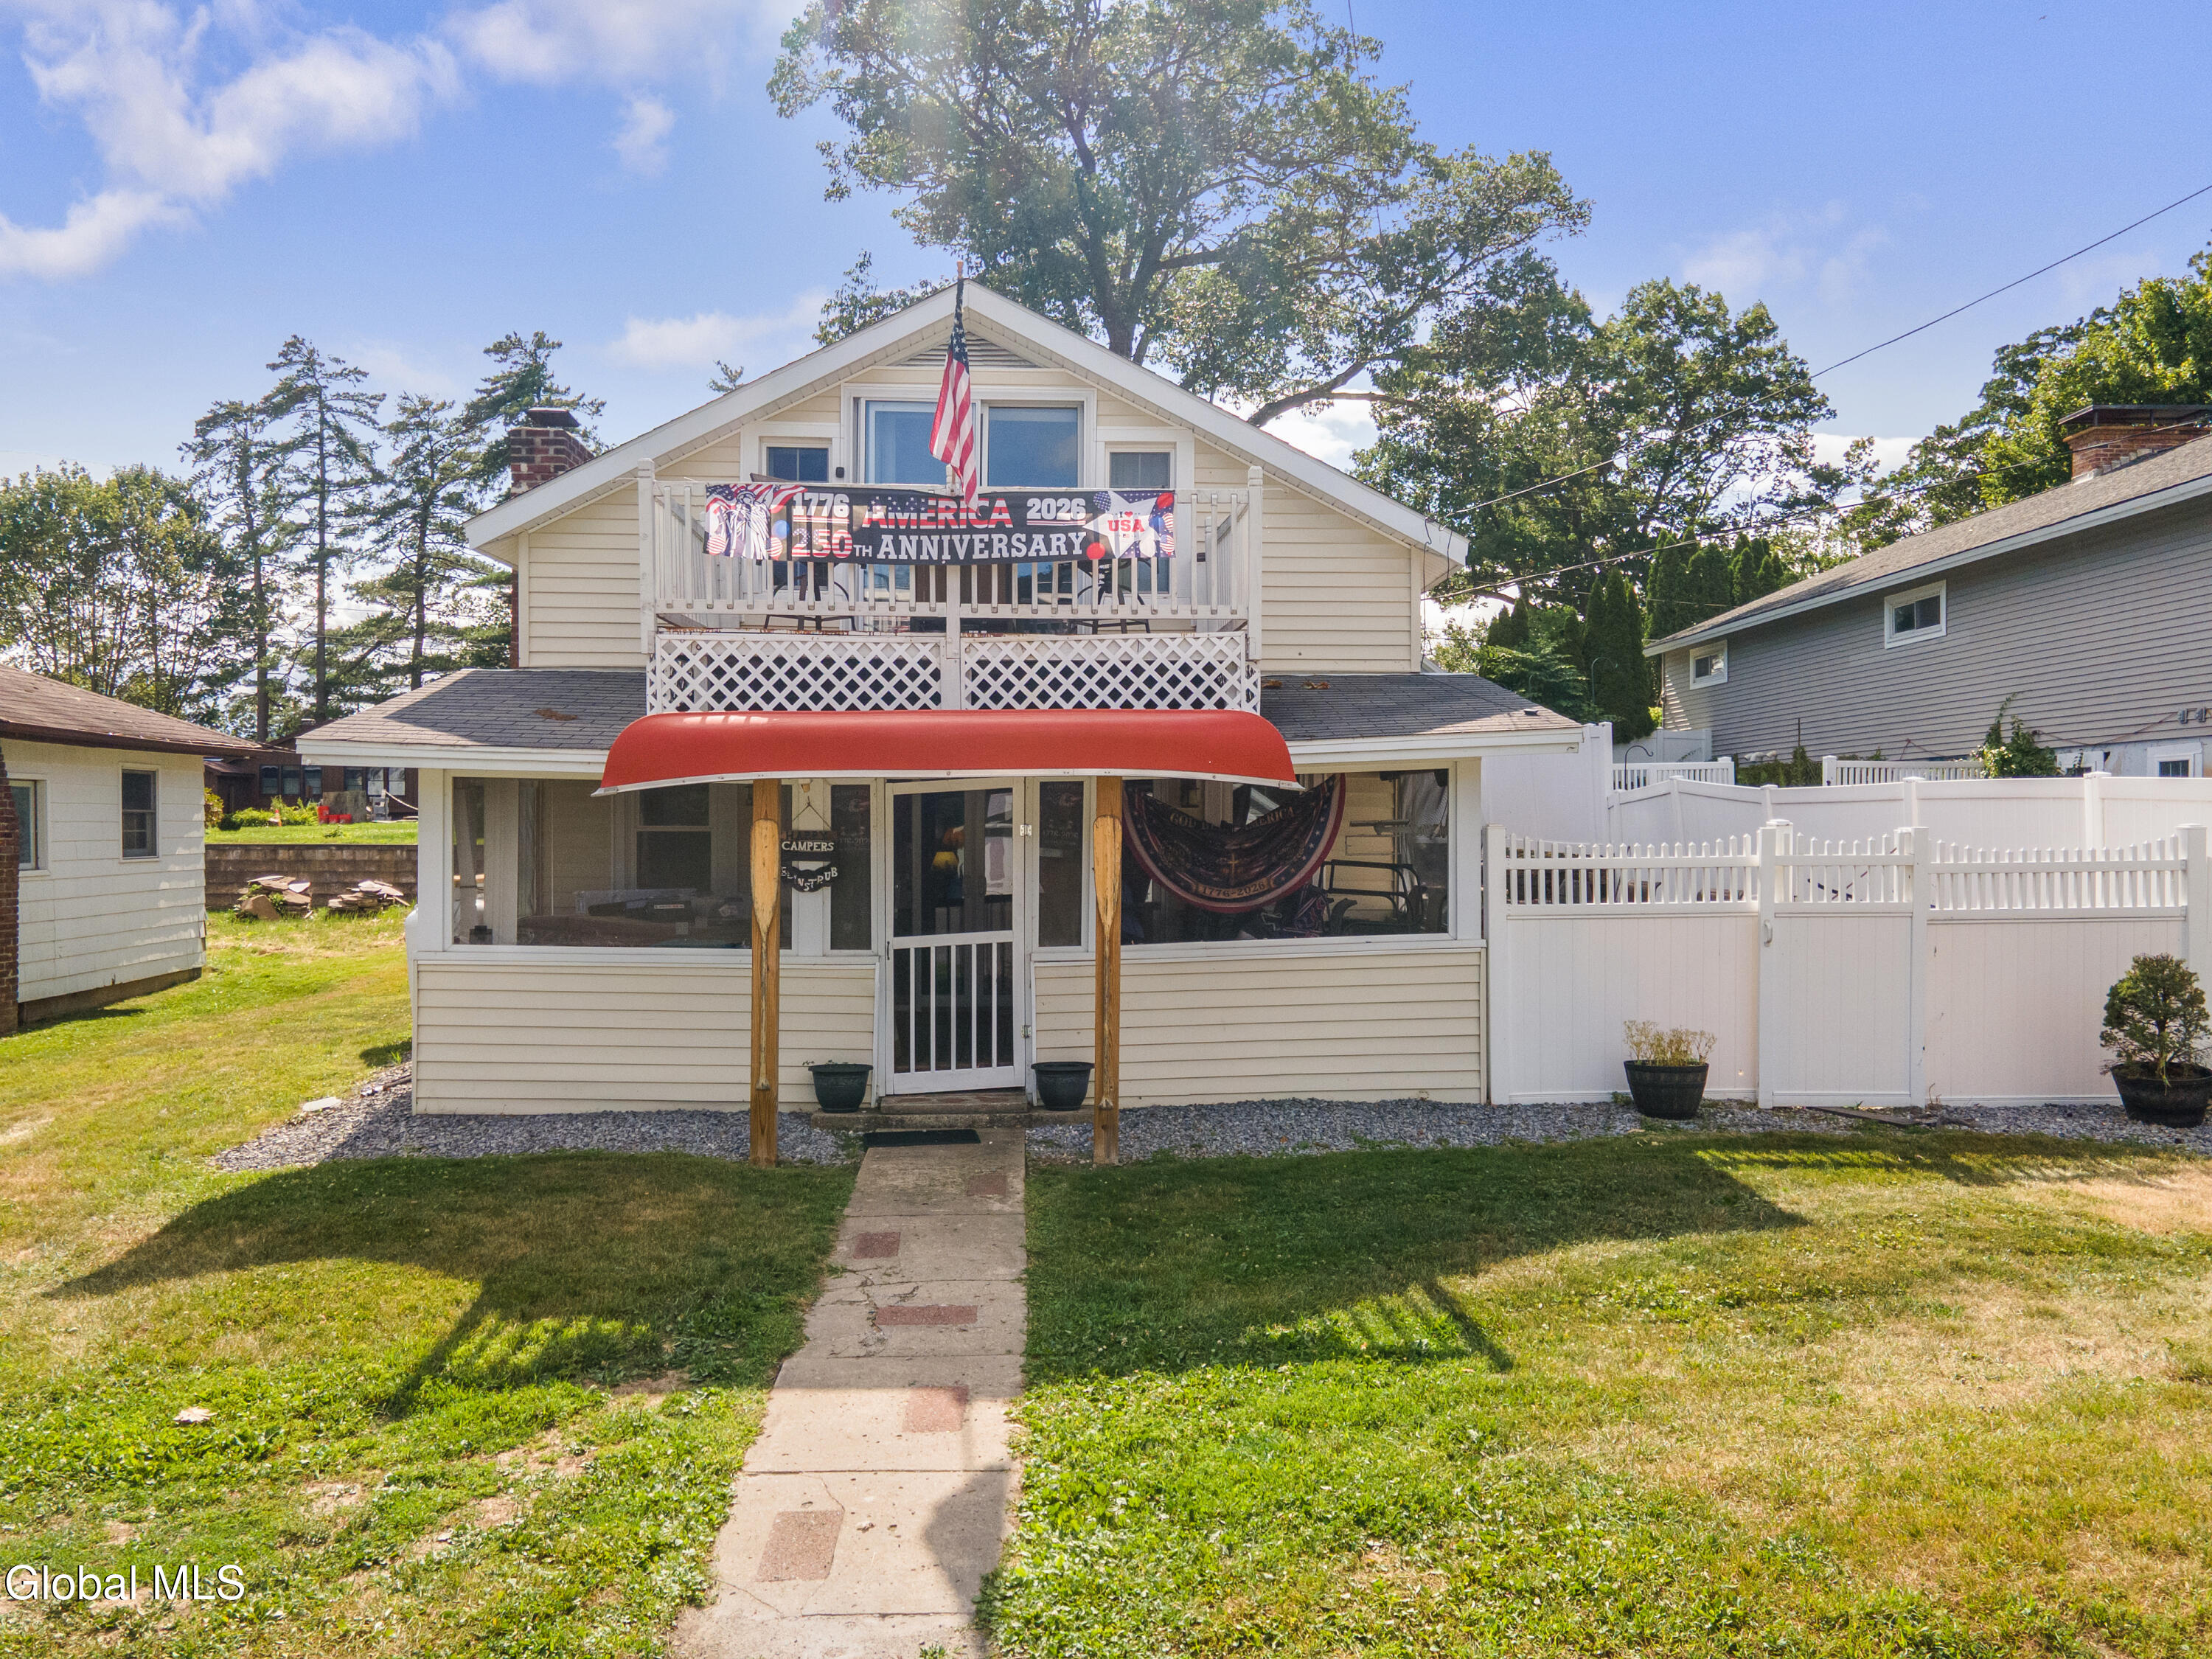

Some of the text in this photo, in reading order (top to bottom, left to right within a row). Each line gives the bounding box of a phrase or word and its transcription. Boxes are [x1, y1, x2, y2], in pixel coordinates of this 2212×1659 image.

[793, 492, 1086, 529] 1776 AMERICA 2026
[1107, 519, 1145, 532] USA
[877, 532, 1087, 560] ANNIVERSARY
[782, 841, 835, 852] CAMPERS
[1203, 882, 1265, 897] 1776-2026
